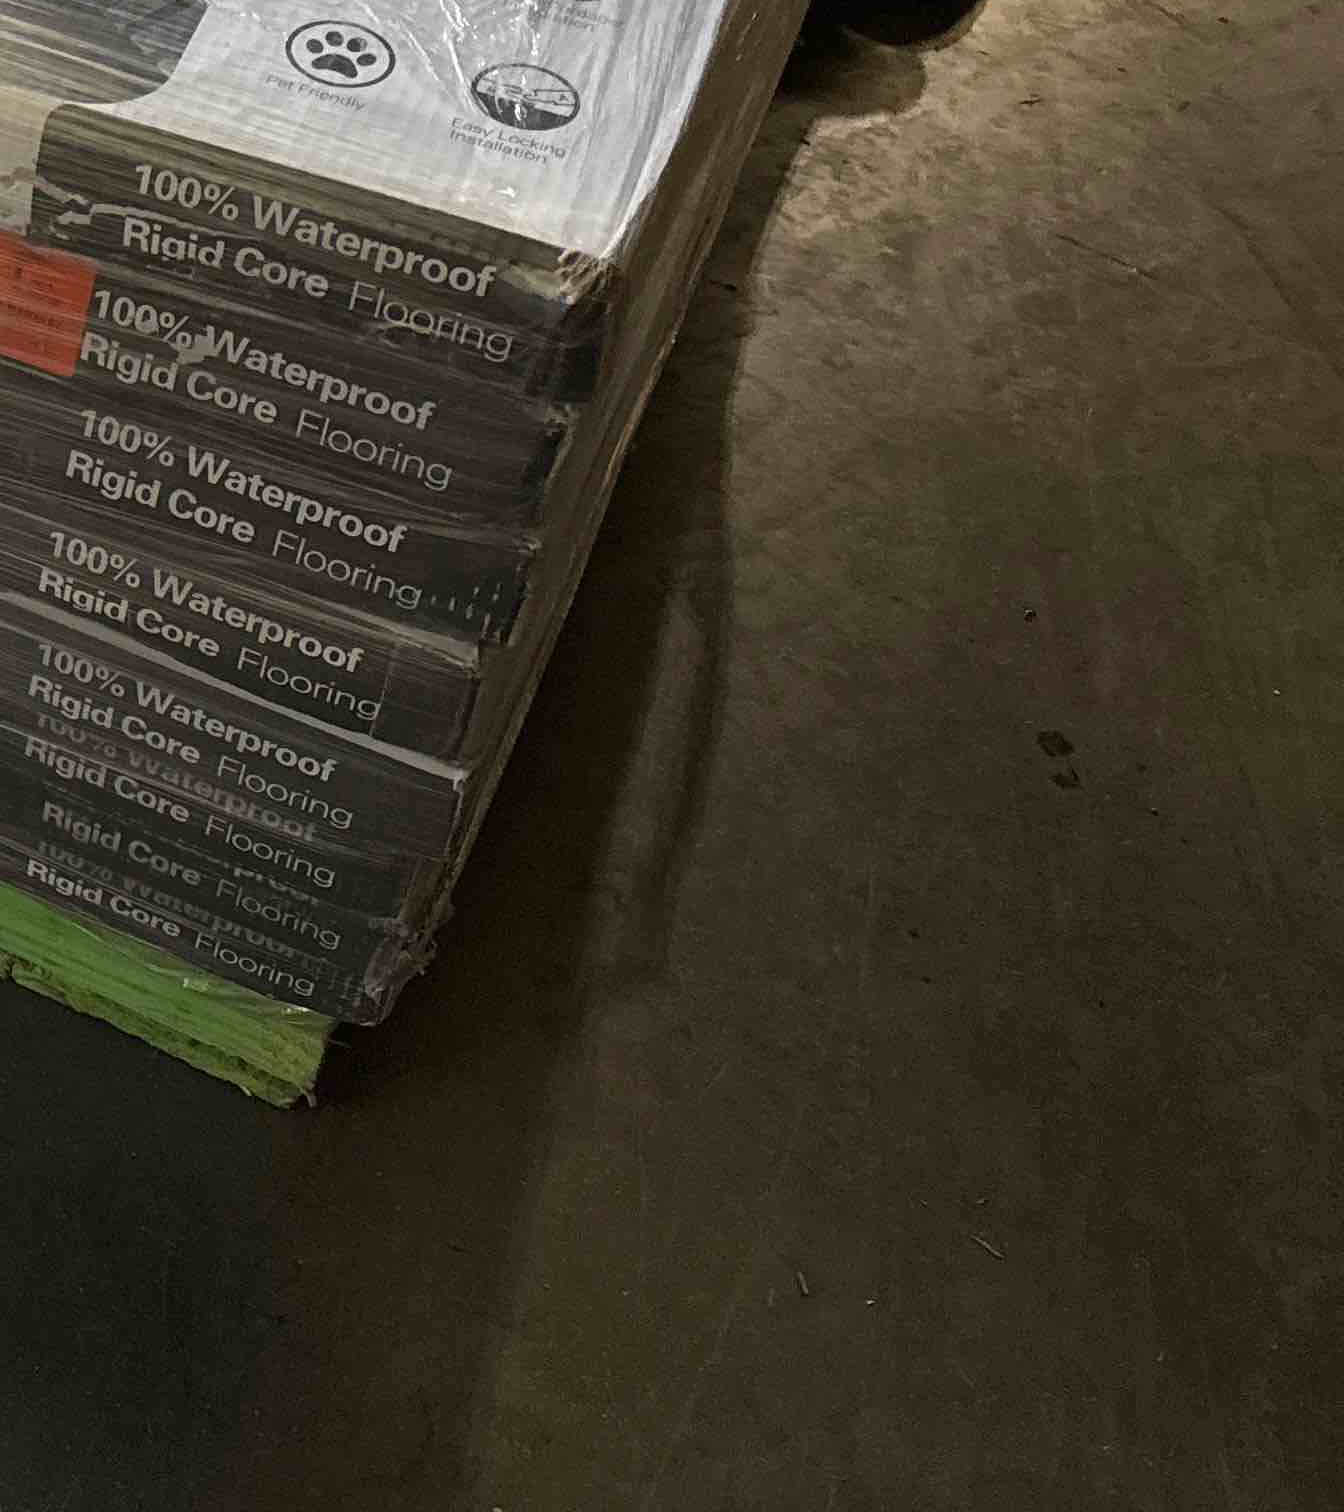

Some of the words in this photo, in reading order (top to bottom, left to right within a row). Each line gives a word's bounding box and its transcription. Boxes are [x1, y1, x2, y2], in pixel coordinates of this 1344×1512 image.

[265, 75, 294, 94] Pet
[295, 79, 367, 112] Friendly
[122, 216, 226, 269] Rigid
[233, 247, 330, 300] Core
[348, 279, 513, 362] Flooring
[136, 164, 239, 222] 100%
[253, 196, 497, 298] Waterproof
[79, 333, 179, 394] Rigid
[187, 371, 279, 426] Core
[296, 409, 454, 494] Flooring
[93, 289, 195, 349] 100%
[205, 325, 437, 432] Waterproof
[65, 449, 162, 509] Rigid
[168, 487, 257, 544] Core
[272, 528, 423, 611] Flooring
[80, 409, 174, 468] 100%
[187, 445, 408, 554] Waterproof
[38, 567, 129, 624] Rigid
[136, 607, 221, 658] Core
[236, 646, 381, 721] Flooring
[49, 531, 141, 590] 100%
[151, 568, 365, 675] Waterproof
[28, 674, 114, 730] Rigid
[120, 714, 201, 766] Core
[217, 754, 354, 831] Flooring
[38, 643, 125, 698] 100%
[135, 680, 340, 784] Waterproof
[23, 737, 107, 789] Rigid
[113, 773, 191, 824] Core
[204, 815, 336, 889] Flooring
[42, 800, 122, 853] Rigid
[127, 838, 202, 887] Core
[215, 878, 343, 952] Flooring
[26, 858, 104, 907] Rigid
[109, 894, 181, 938] Core
[193, 933, 316, 998] Flooring
